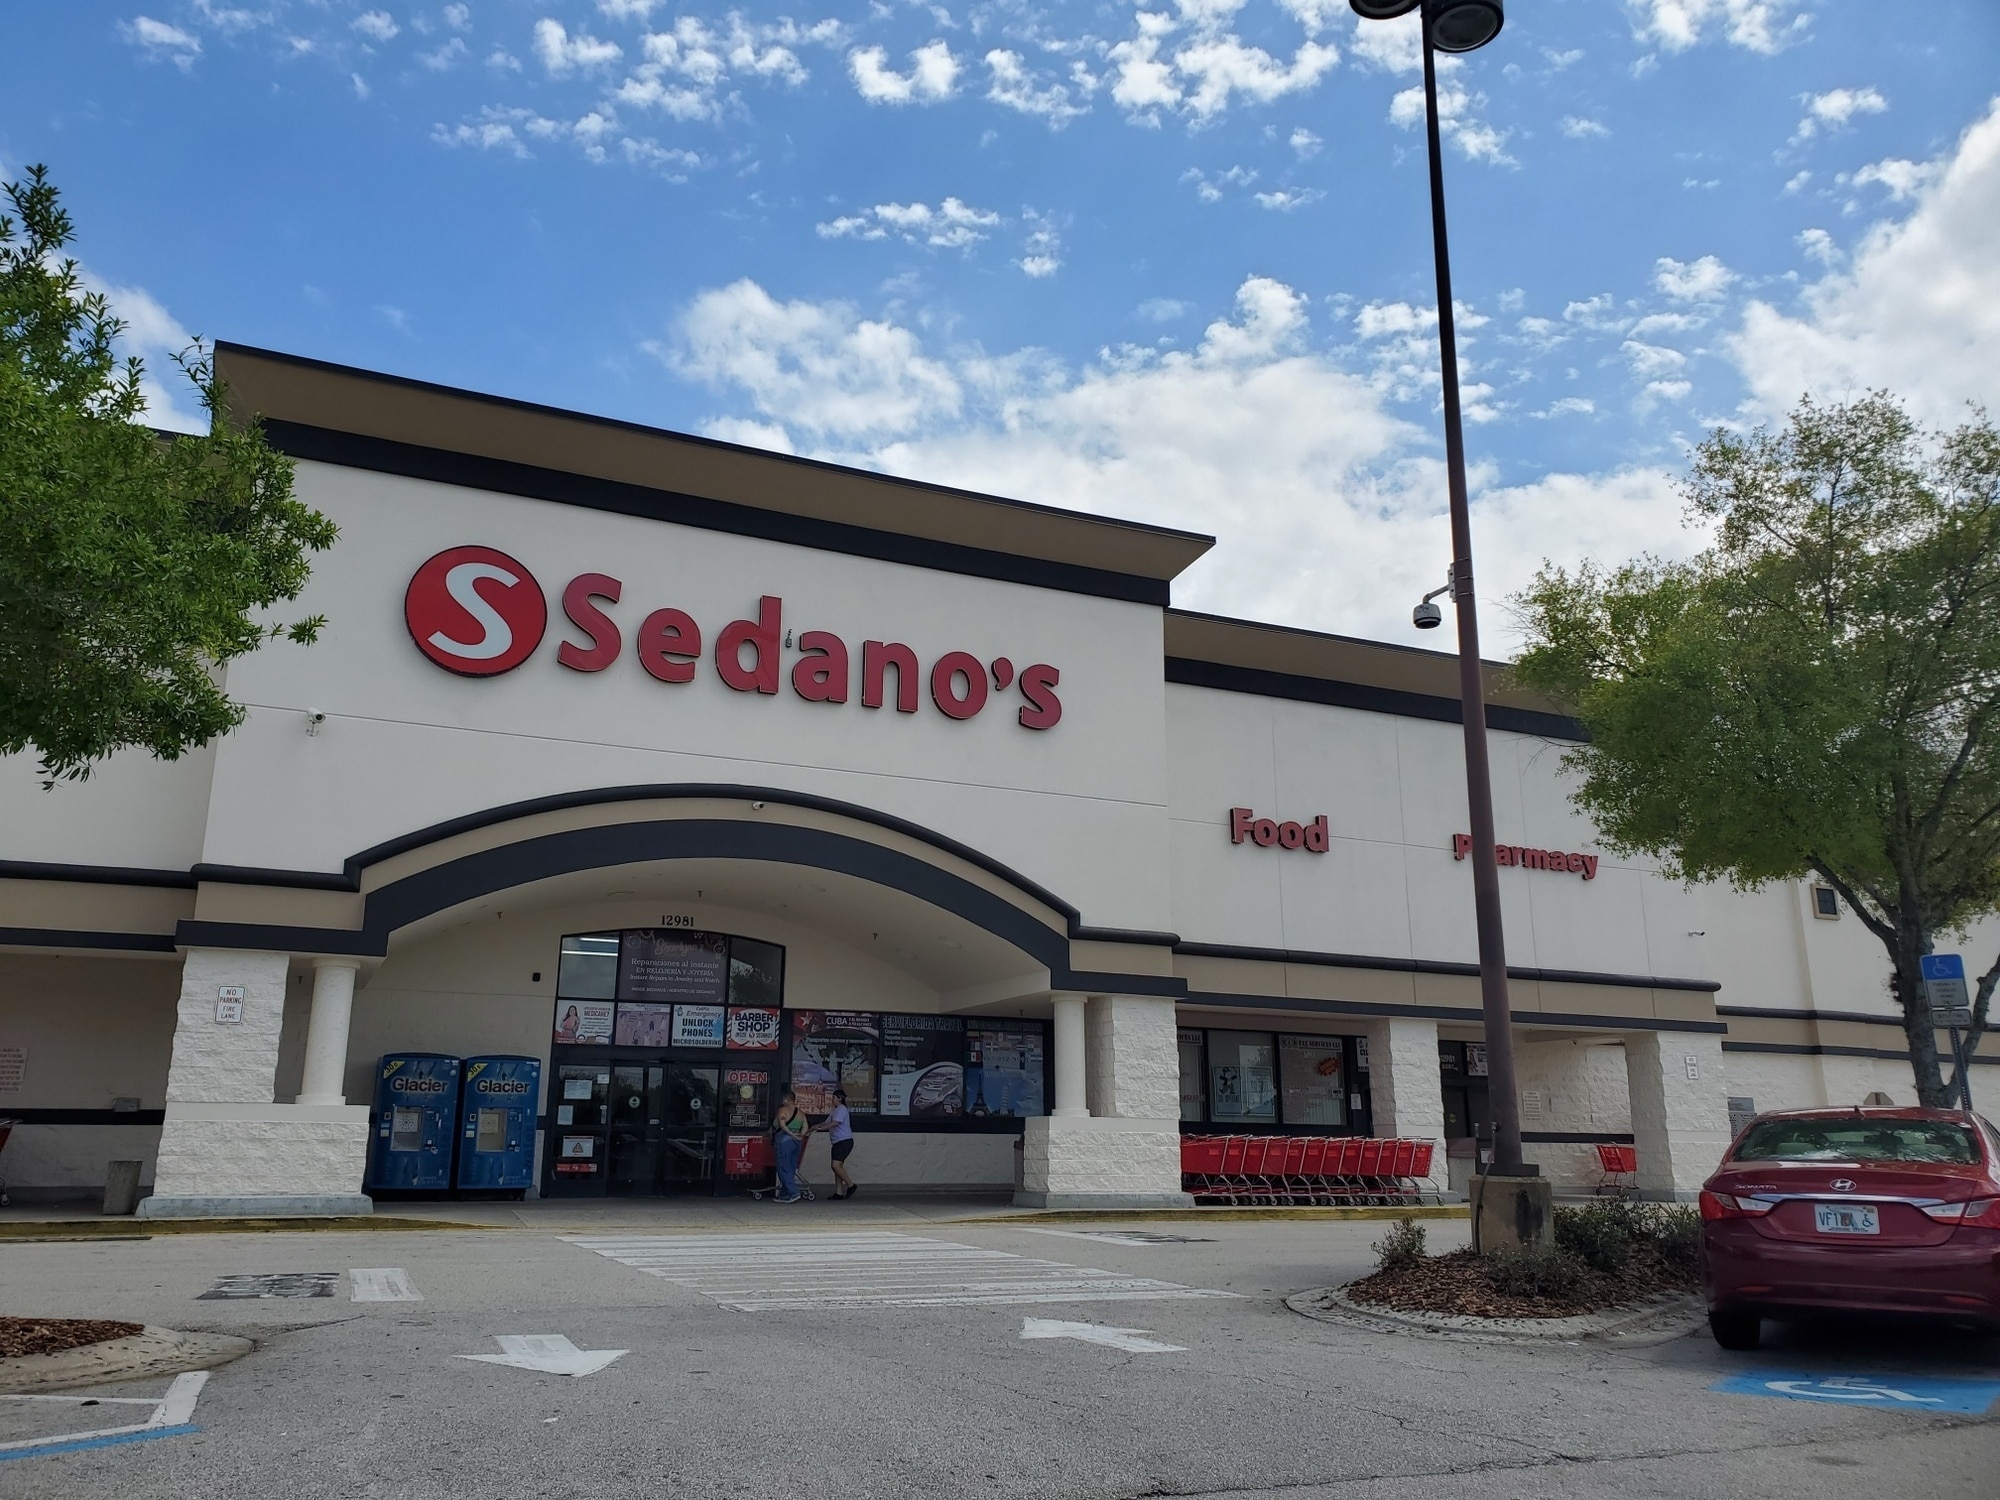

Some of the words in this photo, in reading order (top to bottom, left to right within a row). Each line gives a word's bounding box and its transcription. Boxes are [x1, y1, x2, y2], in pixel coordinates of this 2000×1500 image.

[557, 572, 1063, 730] Sedano's
[1229, 807, 1330, 853] Food
[1452, 833, 1599, 880] Parmacy
[661, 915, 694, 927] 12981
[631, 958, 680, 967] Reparaciones
[691, 961, 719, 969] instante
[220, 996, 242, 1004] PARKING
[686, 1010, 722, 1018] Emergency
[734, 1012, 773, 1022] BARBER
[682, 1018, 714, 1028] UNLOCK
[737, 1021, 771, 1032] SHOP
[826, 1016, 848, 1026] CUBA
[681, 1028, 713, 1038] PHONES
[728, 1071, 768, 1084] OPEN
[392, 1077, 448, 1092] Glacier
[476, 1079, 530, 1093] Glacier
[1734, 1183, 1778, 1191] SONATA
